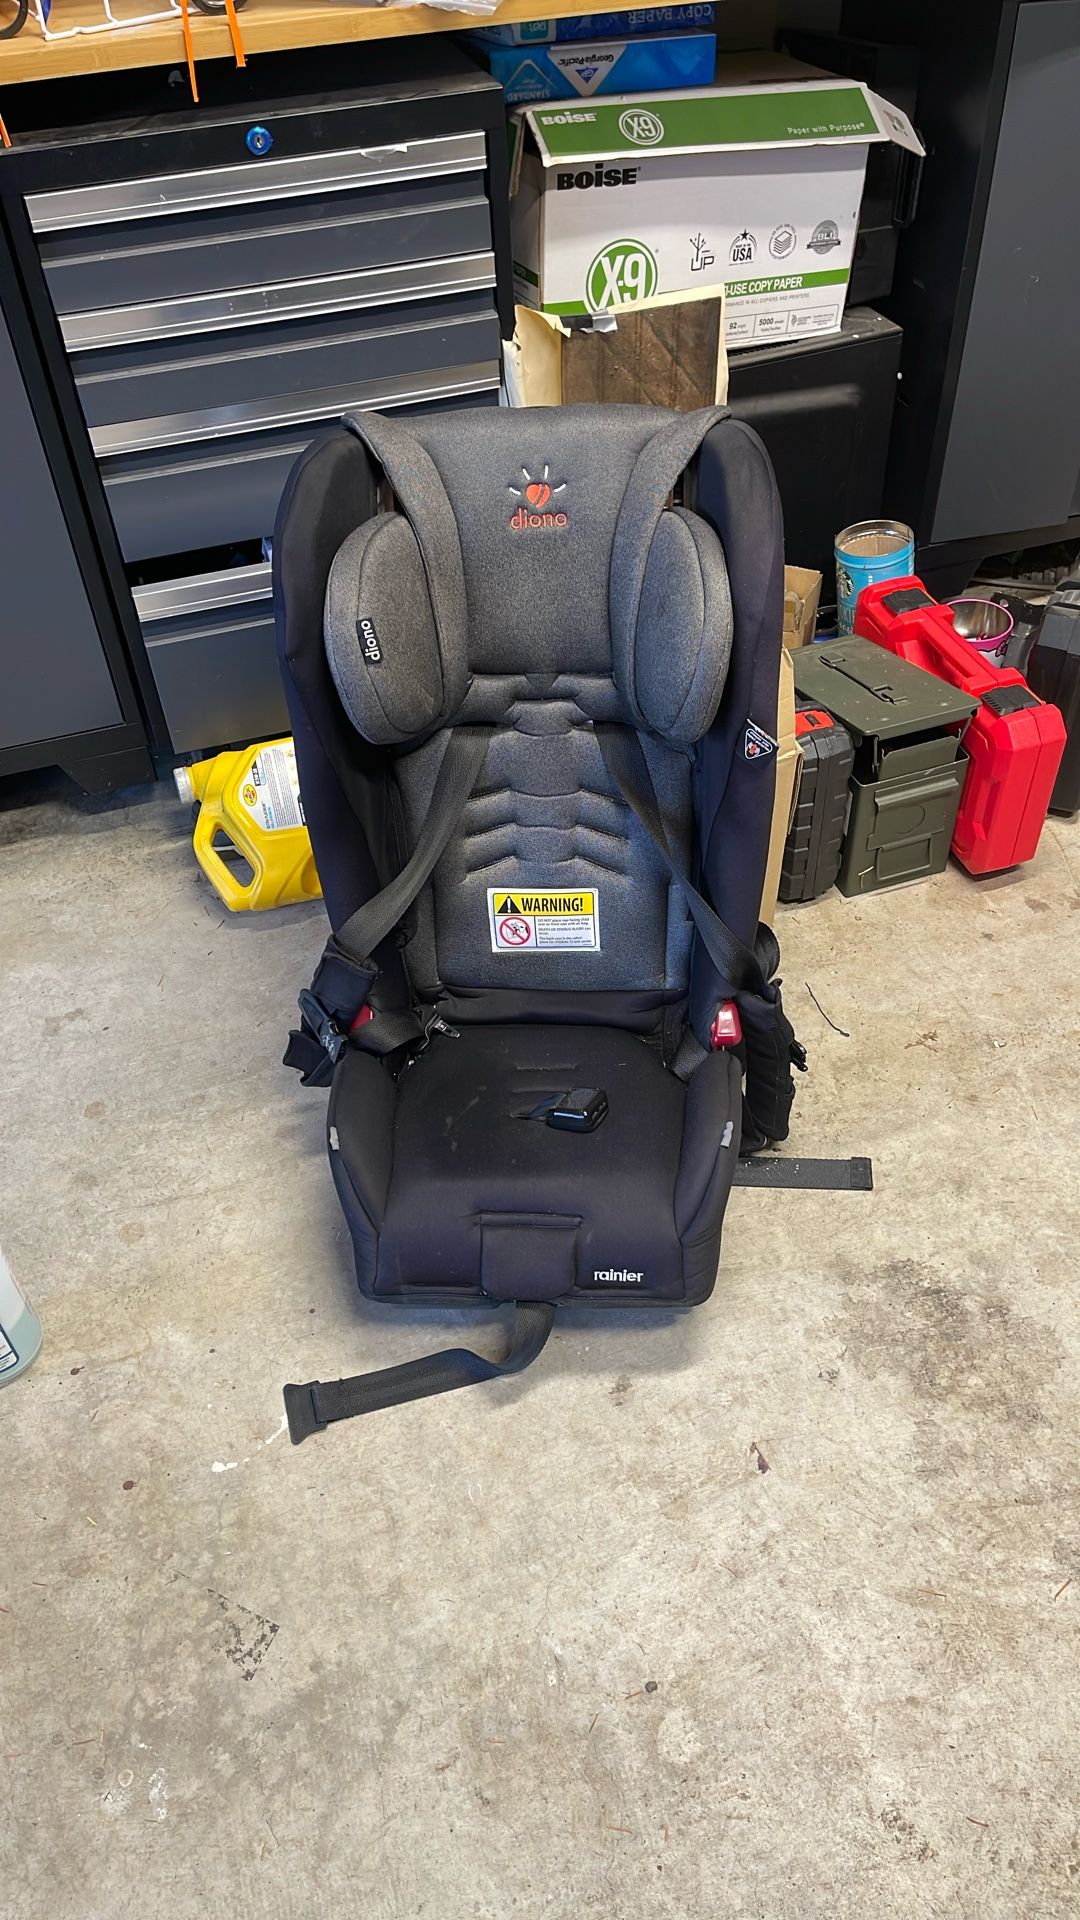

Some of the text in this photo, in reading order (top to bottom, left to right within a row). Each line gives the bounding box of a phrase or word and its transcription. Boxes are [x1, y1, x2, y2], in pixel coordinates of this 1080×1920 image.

[628, 4, 712, 24] COPY PAPER
[558, 54, 614, 67] Georgia-Pacific
[507, 90, 550, 102] STANDARD
[787, 126, 810, 135] Paper
[812, 124, 828, 133] with
[732, 247, 752, 262] USA
[748, 281, 773, 293] COPY
[773, 276, 803, 290] PAPER
[759, 318, 774, 326] 5000
[509, 507, 568, 529] diono
[360, 620, 381, 661] diono
[521, 897, 583, 912] WARNING!
[593, 1268, 644, 1282] rainier
